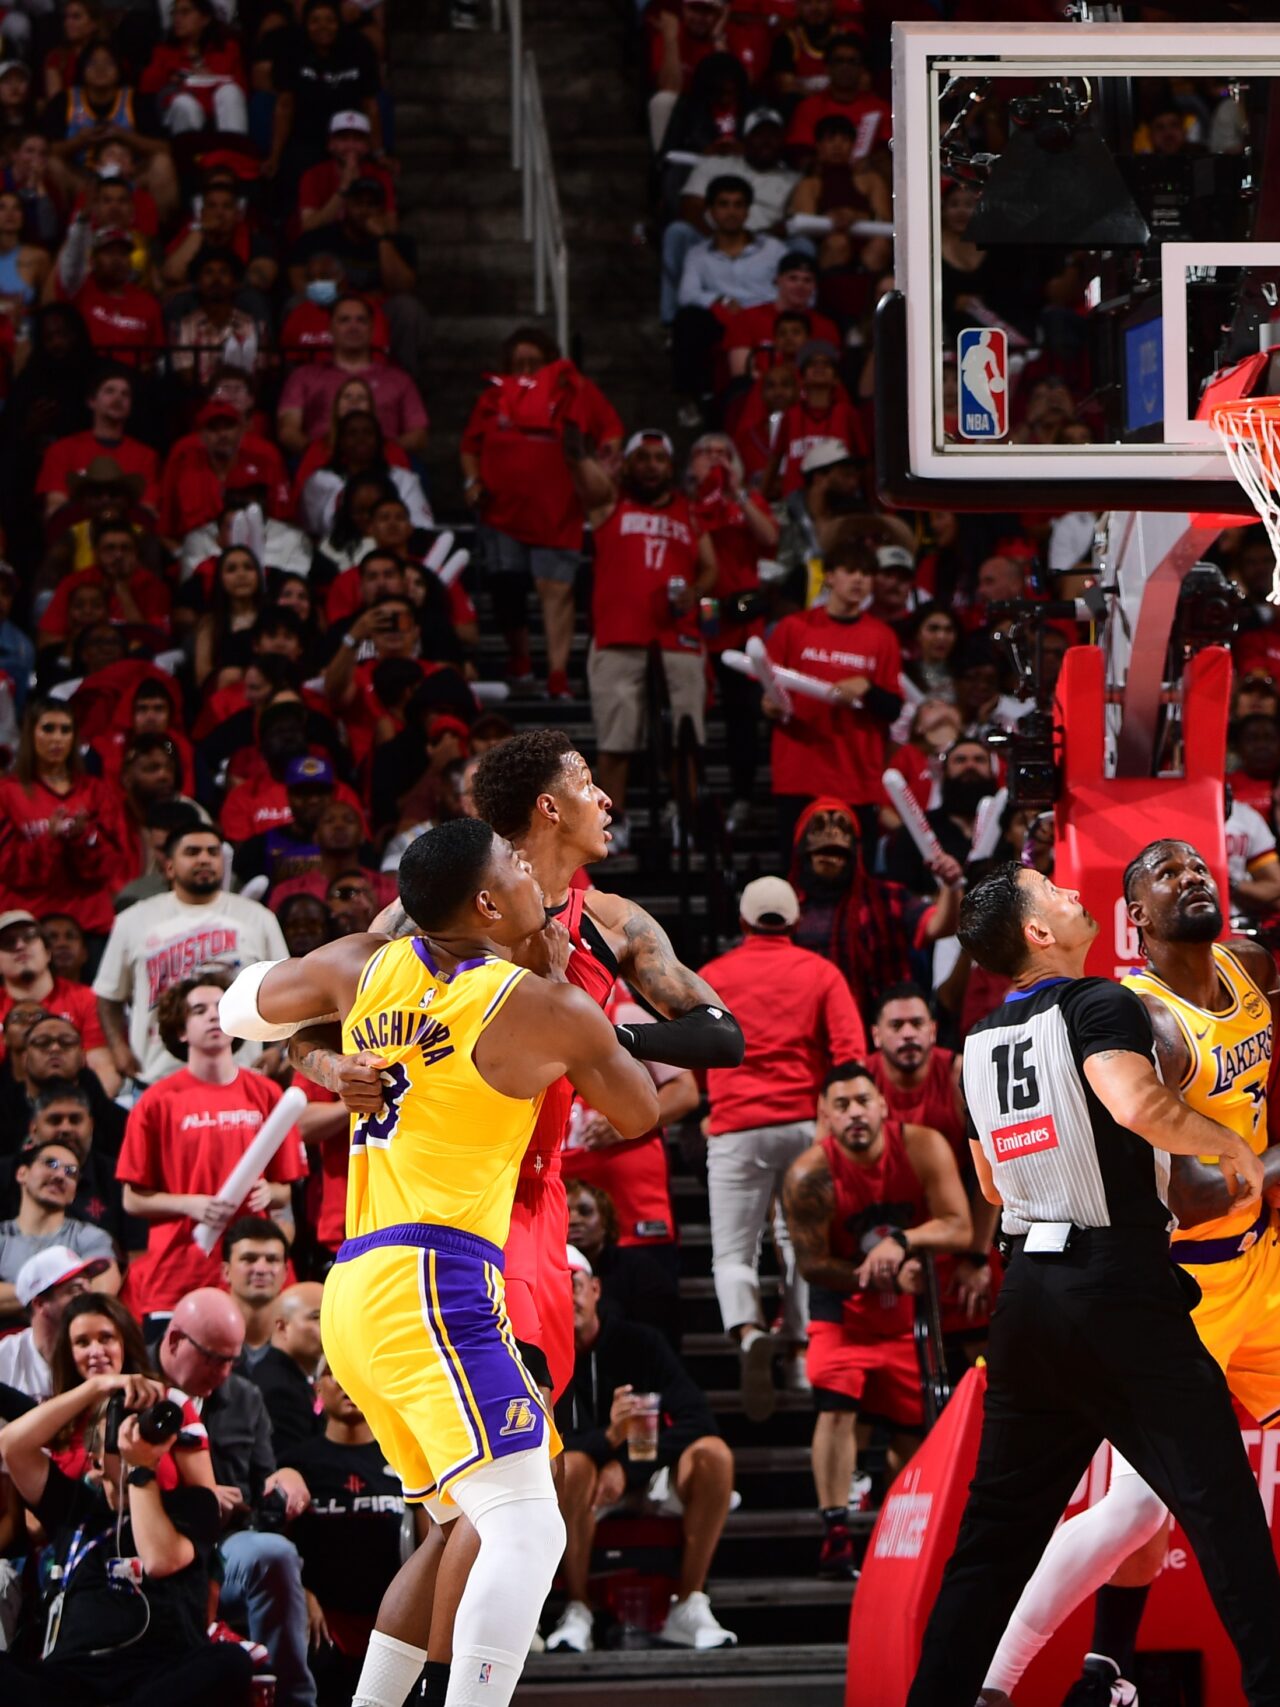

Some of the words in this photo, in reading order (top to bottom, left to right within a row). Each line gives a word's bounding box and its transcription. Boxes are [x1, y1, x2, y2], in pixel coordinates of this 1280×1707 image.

[966, 413, 990, 431] NBA
[991, 1036, 1041, 1115] 15
[350, 1061, 414, 1156] 8
[181, 1110, 217, 1131] ALL
[996, 1127, 1051, 1153] Emirates
[311, 1497, 346, 1514] LL
